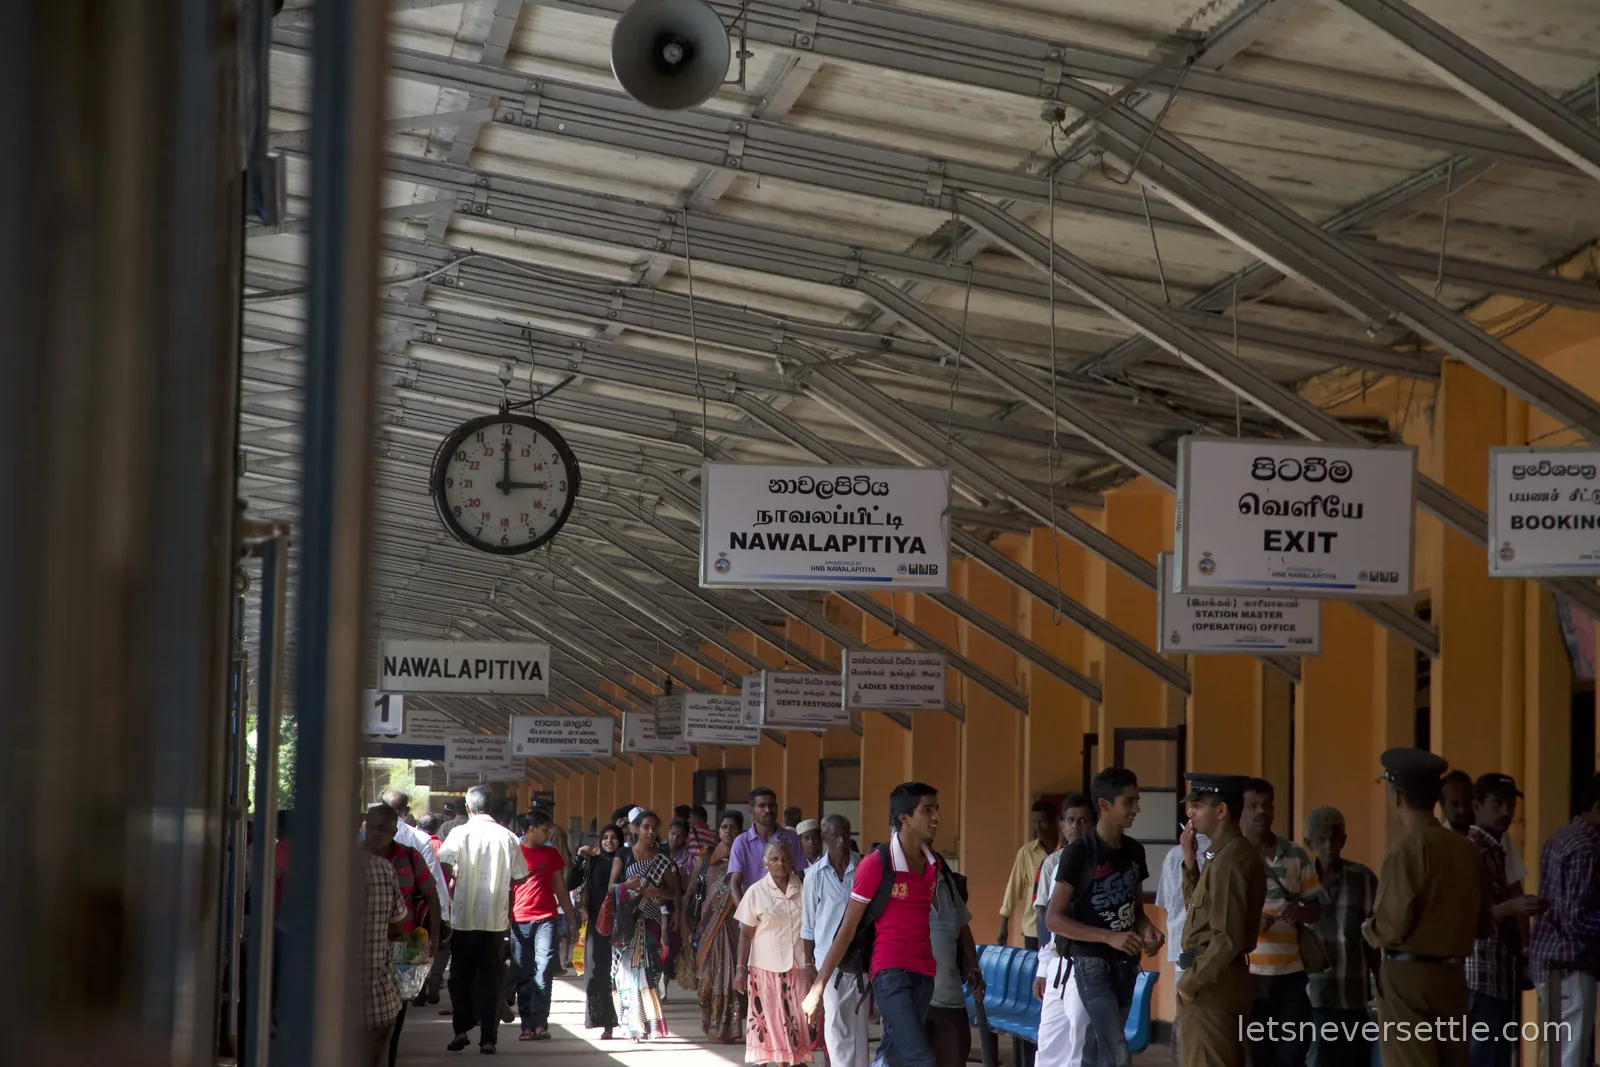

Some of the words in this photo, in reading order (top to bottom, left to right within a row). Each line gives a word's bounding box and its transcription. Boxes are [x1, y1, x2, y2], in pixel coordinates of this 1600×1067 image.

[502, 424, 513, 435] 12
[476, 432, 485, 443] 11
[455, 451, 466, 462] 10
[484, 448, 494, 457] 23
[521, 449, 530, 458] 13
[552, 454, 560, 465] 2
[469, 461, 479, 470] 22
[534, 463, 543, 472] 14
[1251, 456, 1353, 483] පිටවීම
[445, 478, 453, 488] 9
[464, 480, 473, 488] 21
[559, 481, 567, 492] 3
[768, 475, 890, 500] නාවලපිටිය
[468, 499, 480, 508] 20
[533, 500, 542, 509] 16
[1238, 492, 1363, 519] வெளியே
[454, 506, 462, 517] 8
[482, 512, 491, 521] 19
[549, 509, 558, 519] 4
[753, 504, 904, 530] நாவலப்பிட்டி
[501, 518, 510, 527] 18
[521, 514, 529, 523] 17
[1511, 515, 1600, 530] BOOKIN
[475, 527, 483, 537] 7
[529, 528, 536, 539] 5
[501, 535, 509, 546] 6
[730, 532, 926, 555] NAWALAPITIYA
[1264, 529, 1338, 554] EXIT
[908, 564, 939, 575] HNB
[1288, 572, 1337, 580] NAWALAPITIYA
[1369, 571, 1400, 583] HNB
[1195, 610, 1238, 619] STATION
[1241, 611, 1283, 619] MASTER
[1192, 622, 1258, 632] (OPERATING)
[1260, 623, 1296, 632] OFFICE
[384, 656, 543, 681] NAWALAPITIYA
[889, 683, 935, 691] RESTROOM
[375, 694, 390, 723] 1
[776, 699, 801, 707] GENTS
